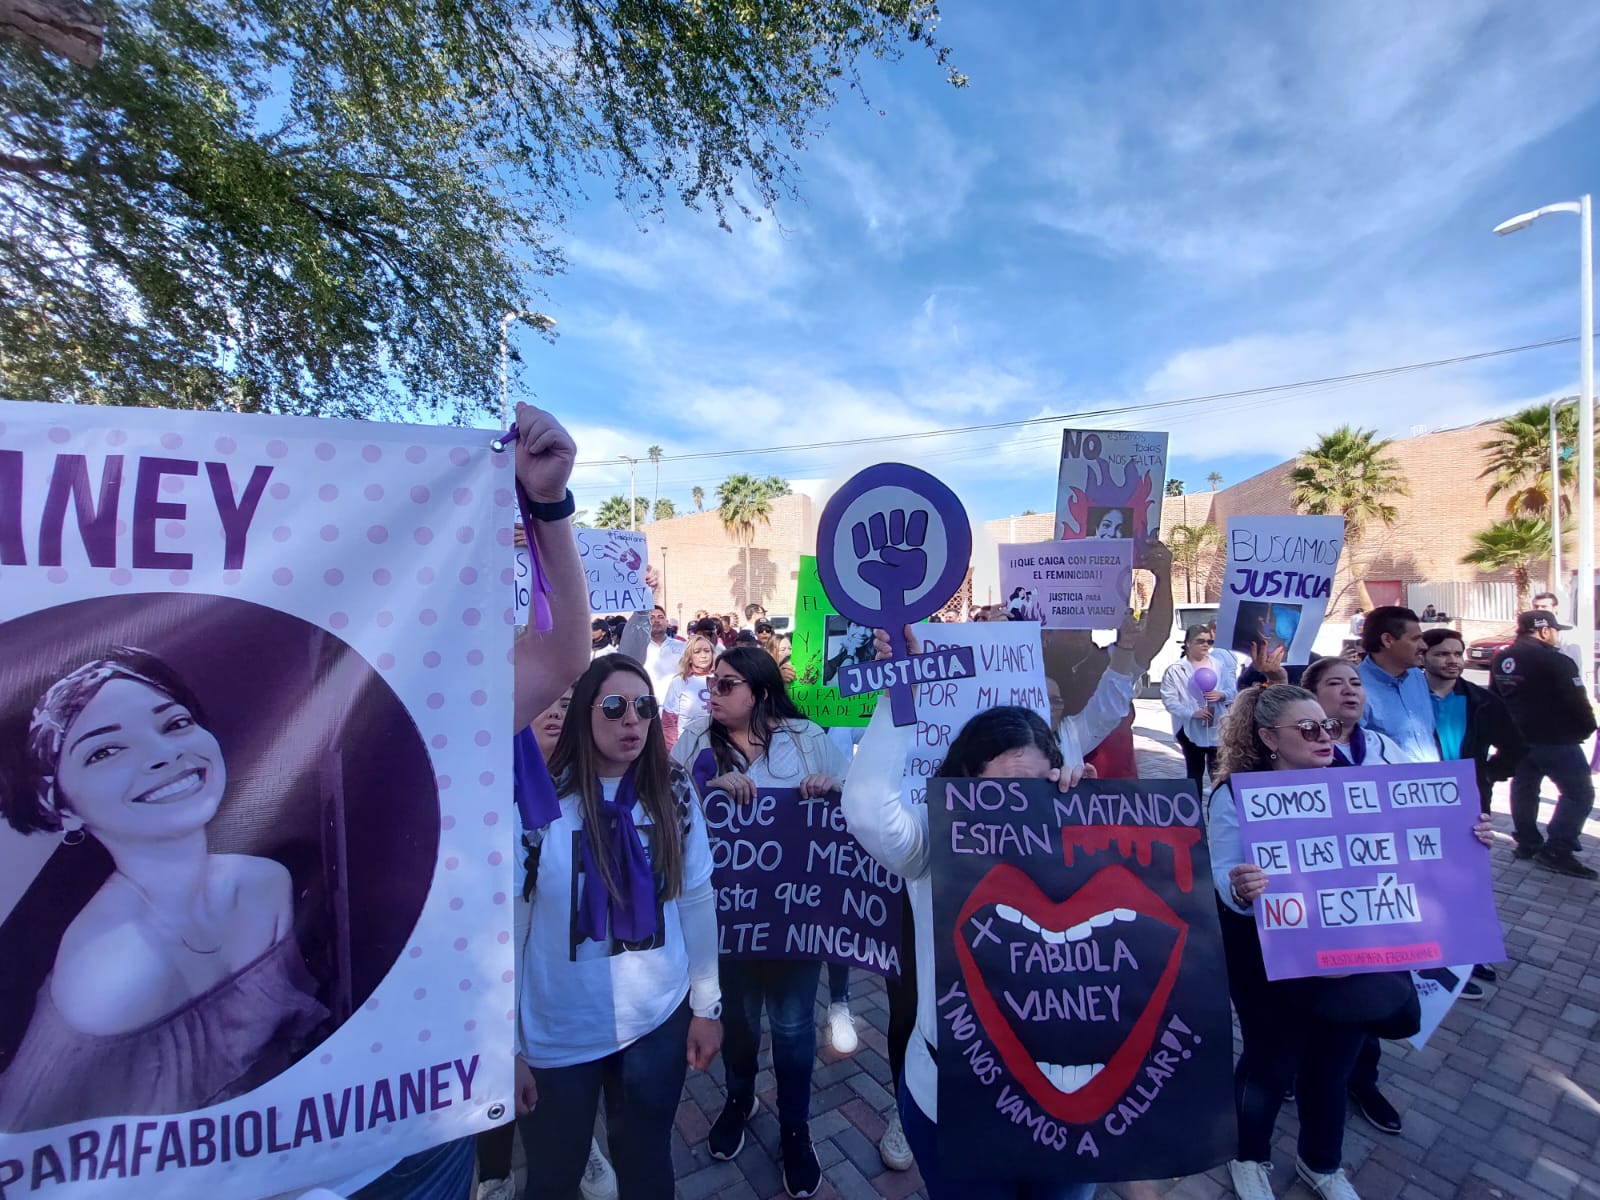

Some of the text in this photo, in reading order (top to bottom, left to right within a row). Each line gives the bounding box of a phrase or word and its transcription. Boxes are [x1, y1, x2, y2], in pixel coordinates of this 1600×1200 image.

[1063, 431, 1102, 460] NO
[1108, 454, 1163, 466] NOS FALTA
[1038, 556, 1065, 567] CAIGA
[1068, 556, 1087, 565] CON
[1089, 556, 1120, 565] FUERZA
[1231, 529, 1339, 566] BUSCAMOS
[1033, 570, 1043, 580] EL
[1229, 568, 1332, 599] JUSTICIA
[1048, 592, 1083, 602] JUSTICIA
[1052, 606, 1116, 616] FABIOLA VIANEY
[847, 654, 967, 693] JUSTICIA
[980, 643, 1034, 672] VIANEY
[919, 683, 958, 708] POR
[976, 686, 999, 709] MI
[916, 721, 951, 747] POR
[945, 780, 1029, 812] NOS
[1250, 781, 1460, 819] SOMOS EL GRITO
[951, 792, 1201, 856] ESTAN MATANDO
[1256, 834, 1437, 870] DE LAS QUE YA
[774, 882, 822, 915] que
[841, 888, 888, 927] NO
[1264, 875, 1416, 929] NO ESTÁN
[785, 923, 902, 976] NINGUNA
[970, 915, 1139, 975] X FABIOLA
[937, 980, 967, 1007] Y
[1003, 984, 1122, 1022] VIANEY
[943, 1003, 976, 1041] NO
[962, 1039, 1002, 1086] NOS
[994, 1085, 1068, 1151] VAMOS
[1076, 1131, 1100, 1158] A
